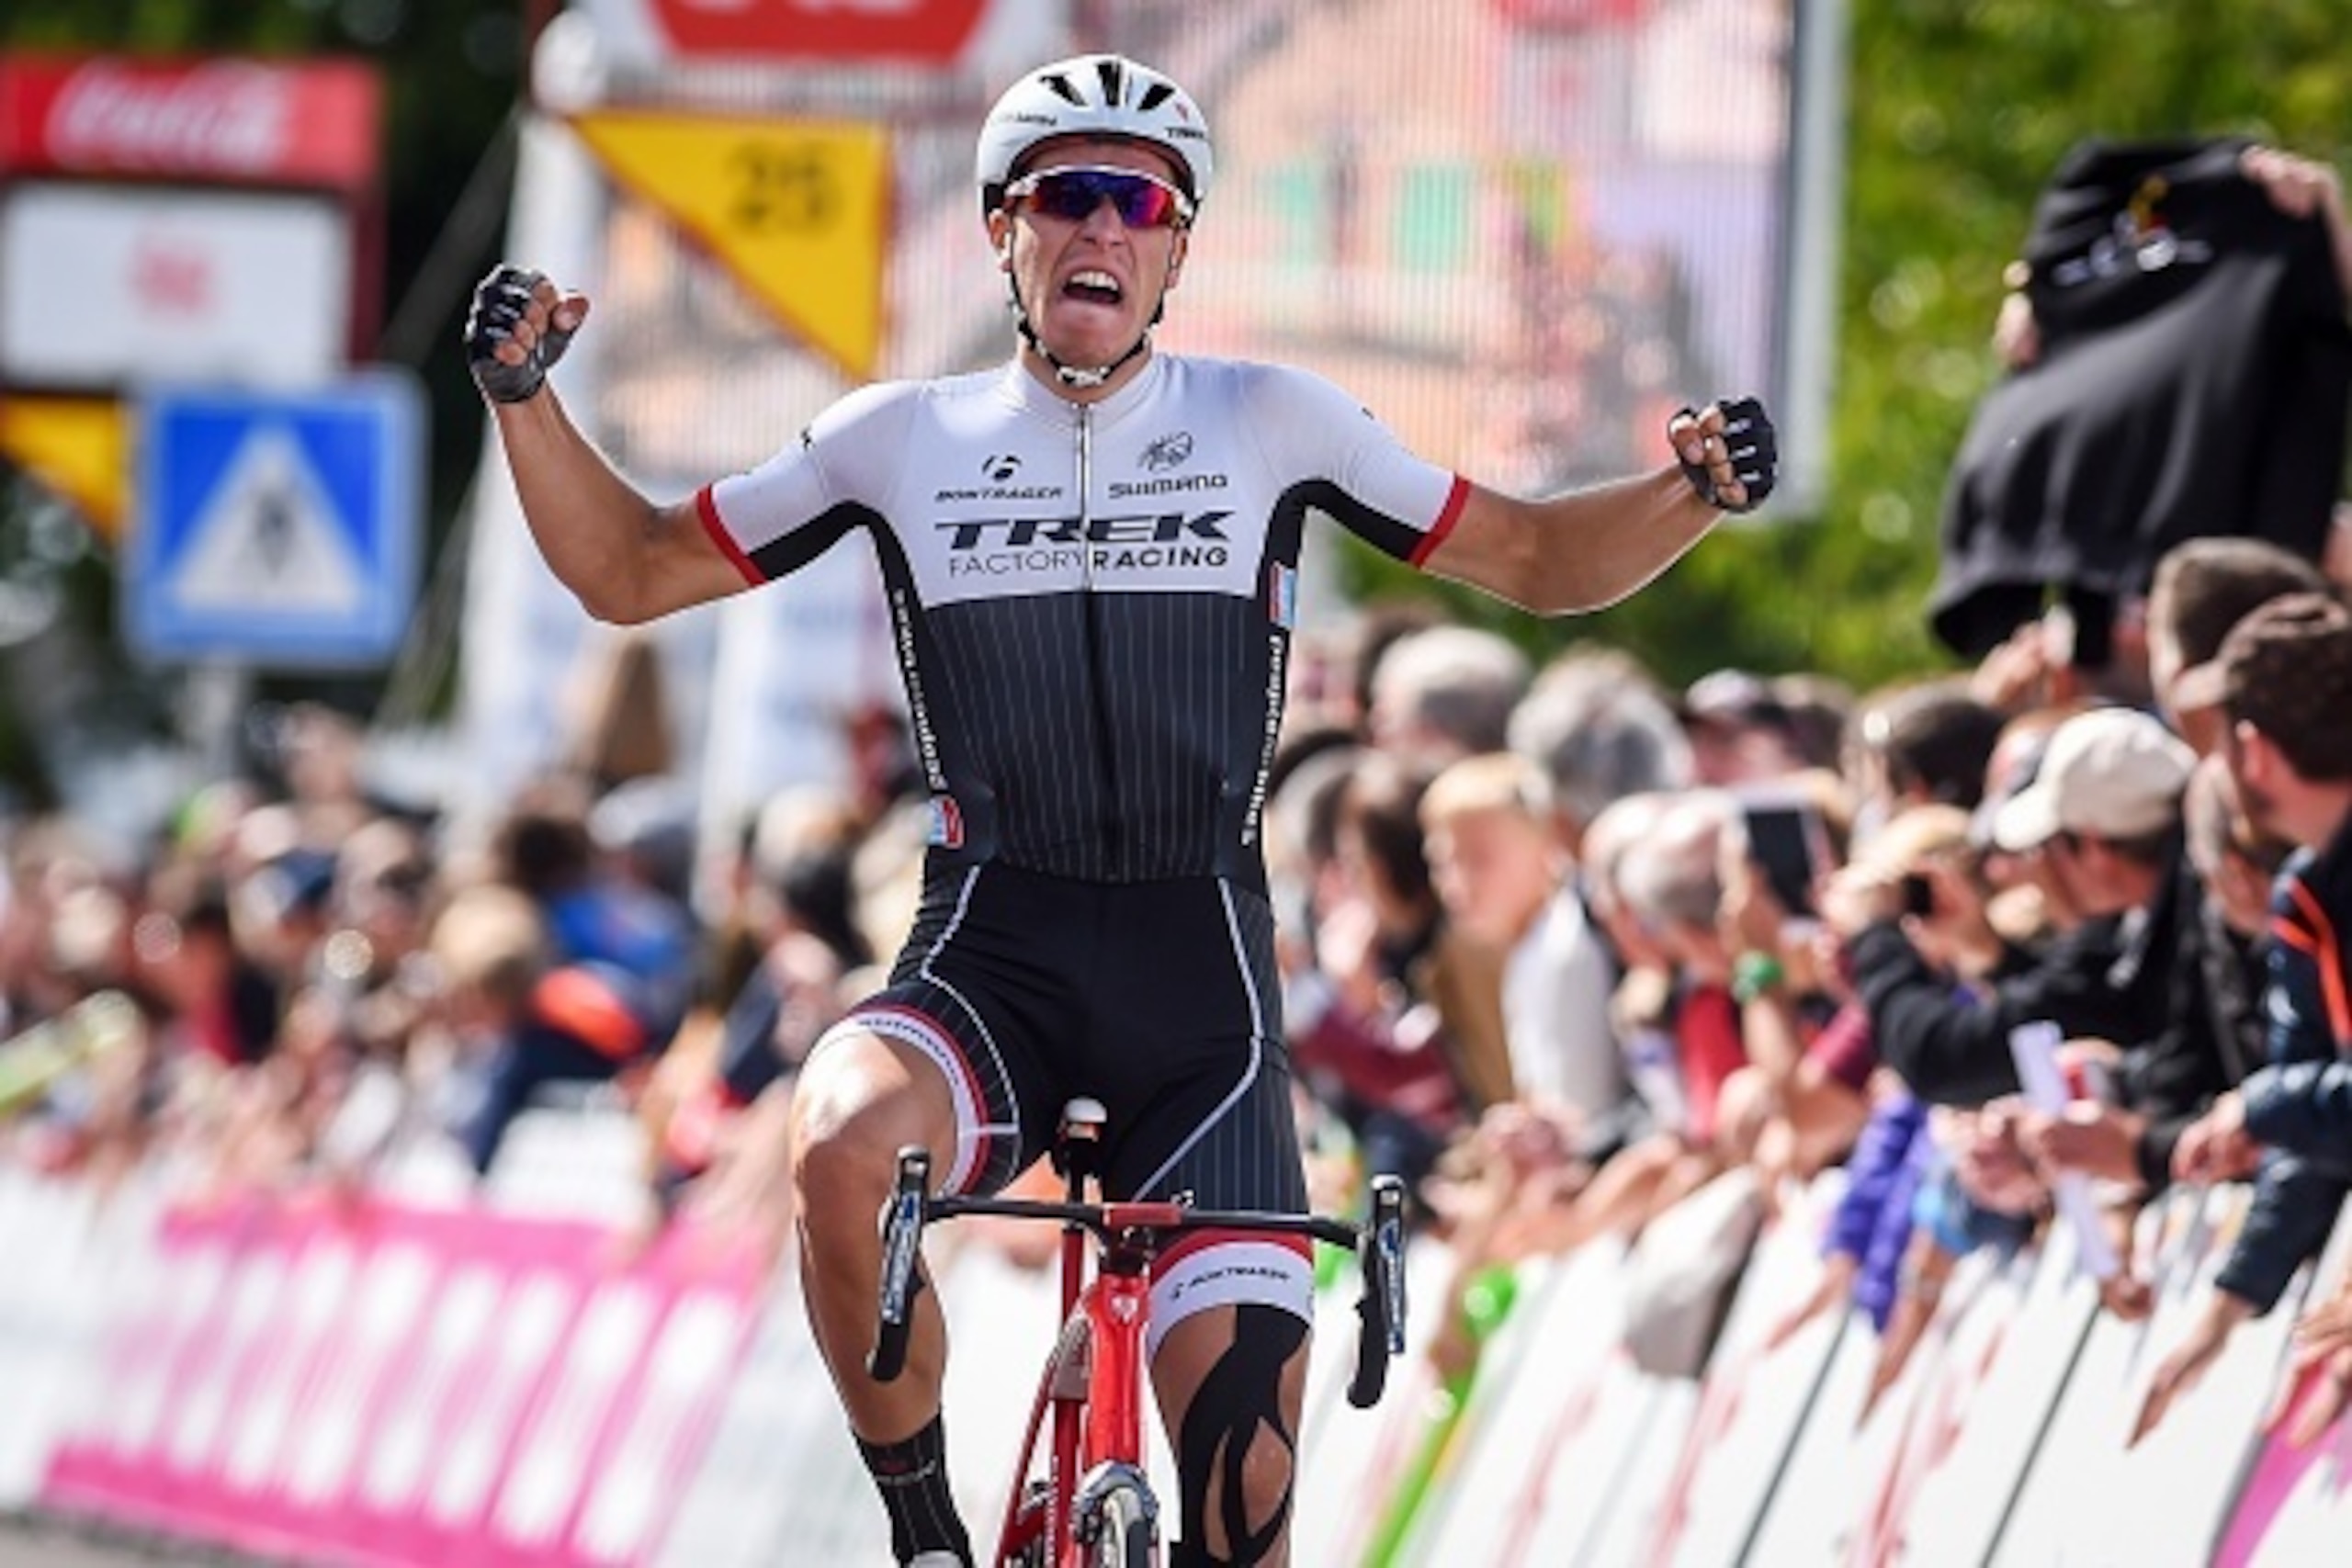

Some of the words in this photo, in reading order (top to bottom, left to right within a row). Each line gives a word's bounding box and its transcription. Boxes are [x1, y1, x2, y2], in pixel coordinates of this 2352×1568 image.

[1108, 474, 1228, 499] SHIMANO
[934, 511, 1236, 550] TREK
[949, 551, 1083, 578] FACTORY
[1092, 547, 1229, 570] RACING
